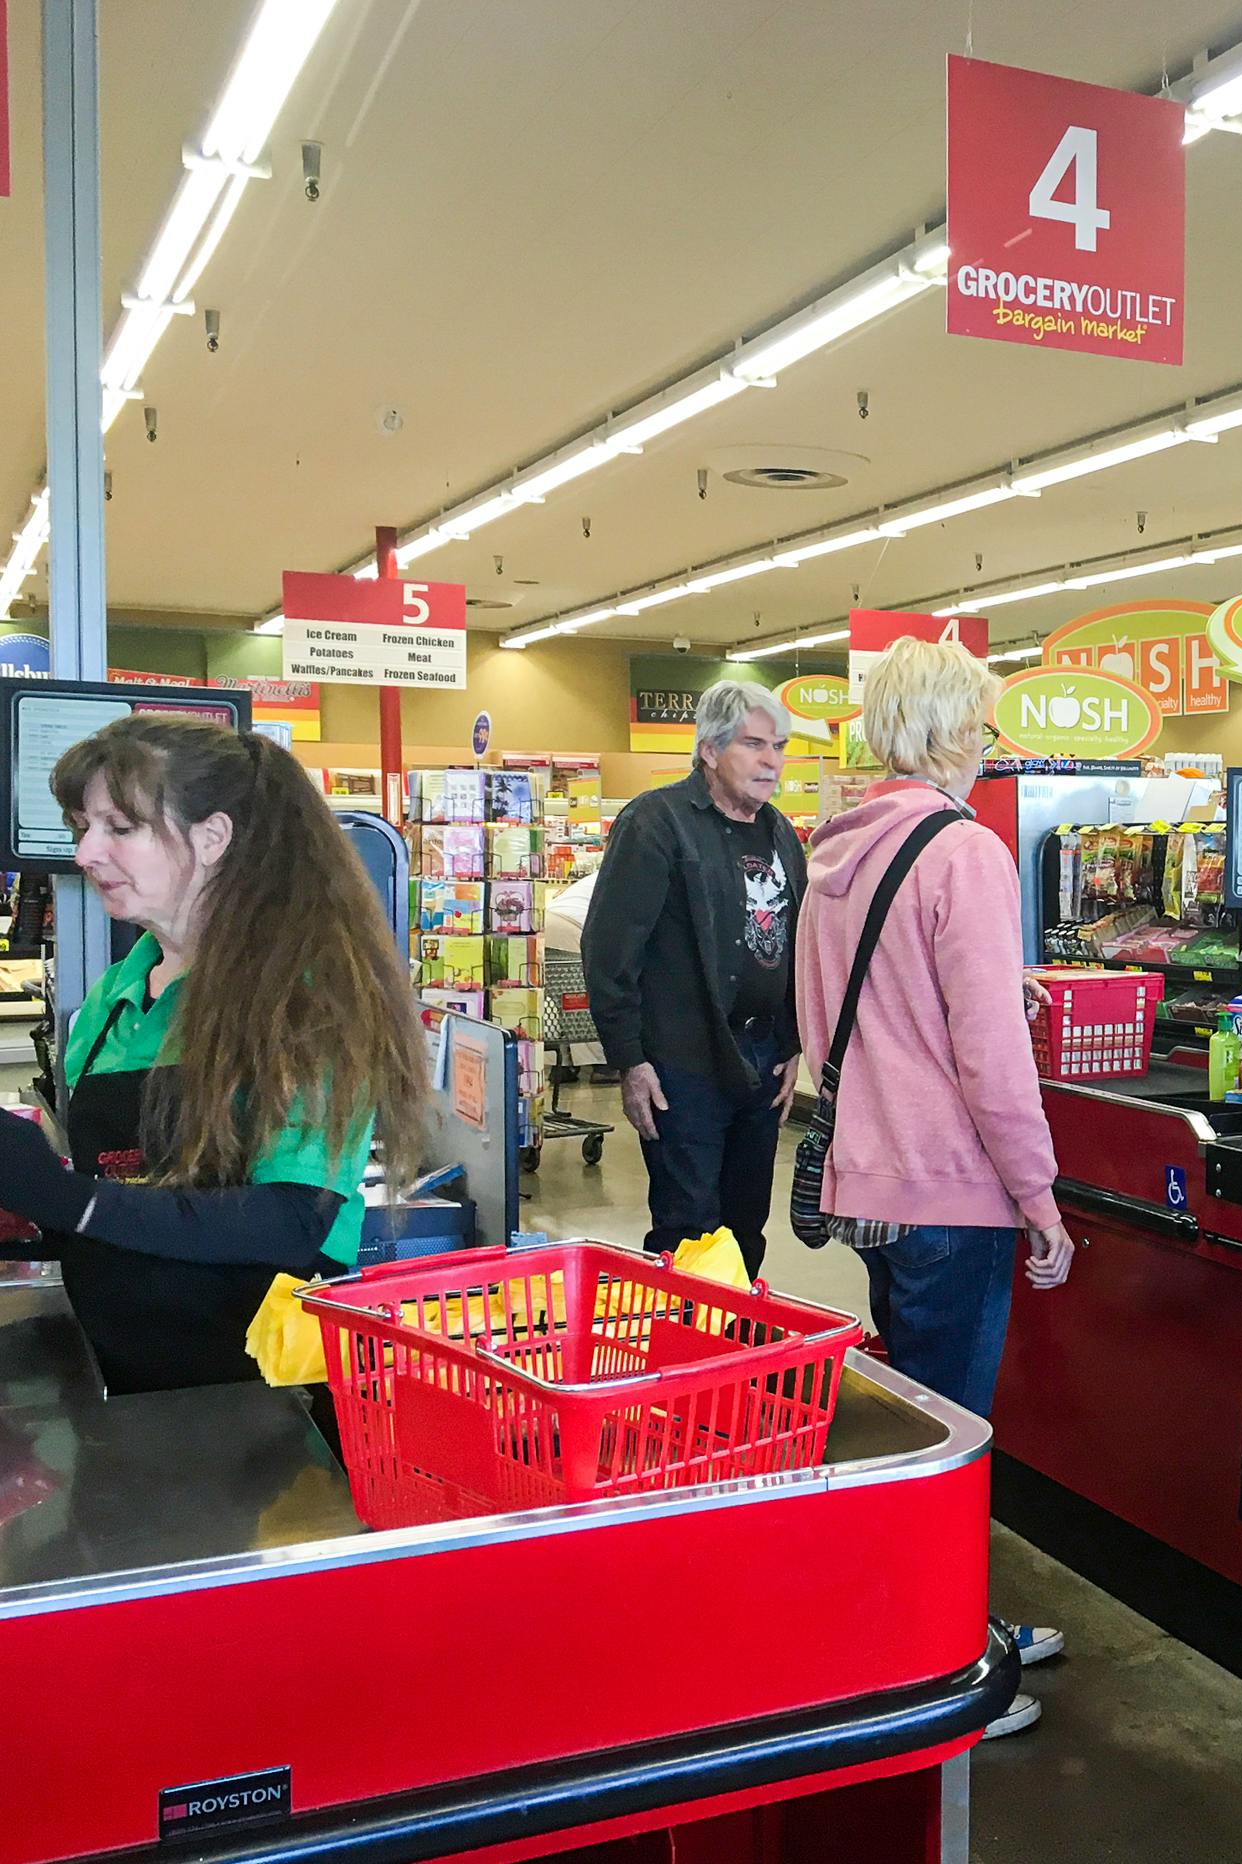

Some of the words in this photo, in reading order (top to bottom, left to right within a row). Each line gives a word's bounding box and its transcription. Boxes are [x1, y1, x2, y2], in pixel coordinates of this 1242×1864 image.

[1029, 125, 1110, 252] 4
[993, 297, 1075, 340] bargain
[1081, 317, 1147, 344] market
[402, 583, 430, 625] 5
[306, 628, 323, 640] Ice
[324, 629, 357, 642] Cream
[382, 633, 414, 645] Frozen
[416, 636, 455, 648] Chicken
[310, 647, 354, 659] Potatoes
[408, 652, 432, 663] Meat
[291, 663, 374, 678] Waffles/Pancakes
[384, 668, 415, 680] Frozen
[417, 670, 456, 683] Seafood
[639, 691, 698, 710] TERR
[1020, 688, 1128, 733] NOSH
[1190, 693, 1223, 708] healthy
[188, 1784, 281, 1816] ROYSTON
